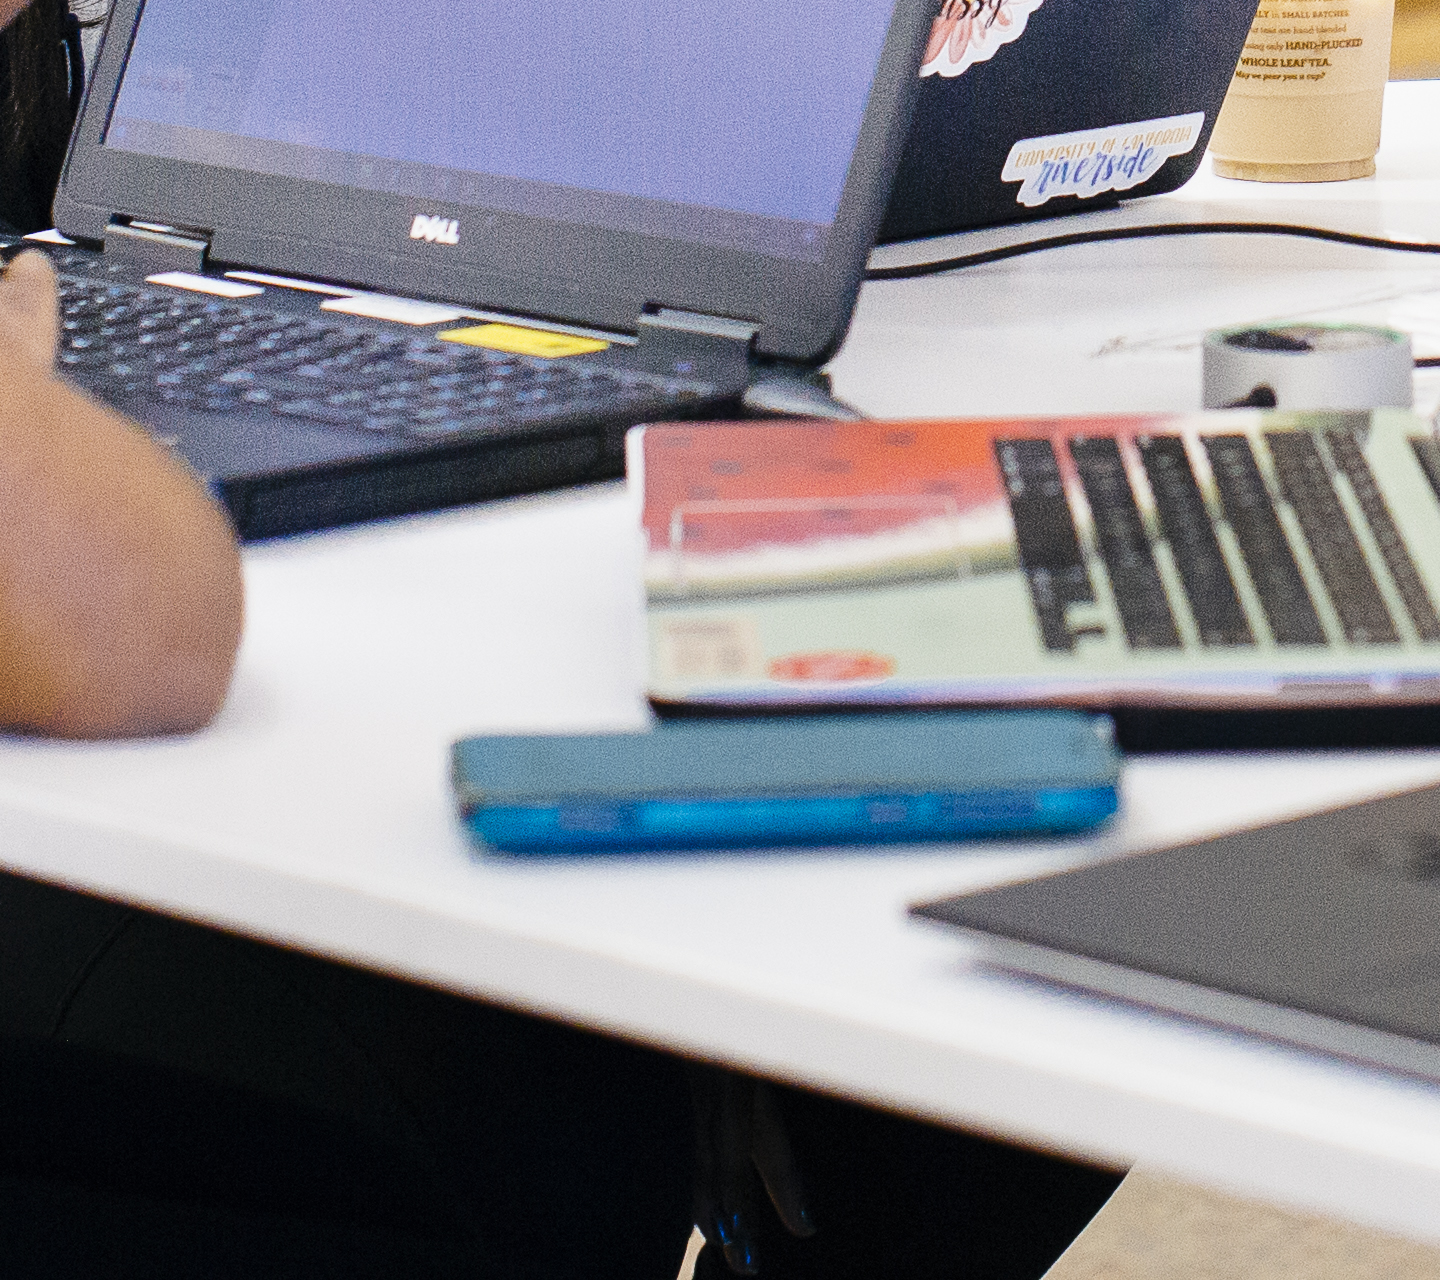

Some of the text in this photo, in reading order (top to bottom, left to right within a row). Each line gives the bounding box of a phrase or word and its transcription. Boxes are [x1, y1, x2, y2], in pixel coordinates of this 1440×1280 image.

[1312, 9, 1349, 18] BATCHES
[1240, 57, 1278, 67] WHOLE
[1279, 58, 1305, 67] LEAF
[1014, 141, 1096, 168] UNIVERSITY
[1033, 142, 1158, 195] riverside
[410, 213, 460, 246] DELL
